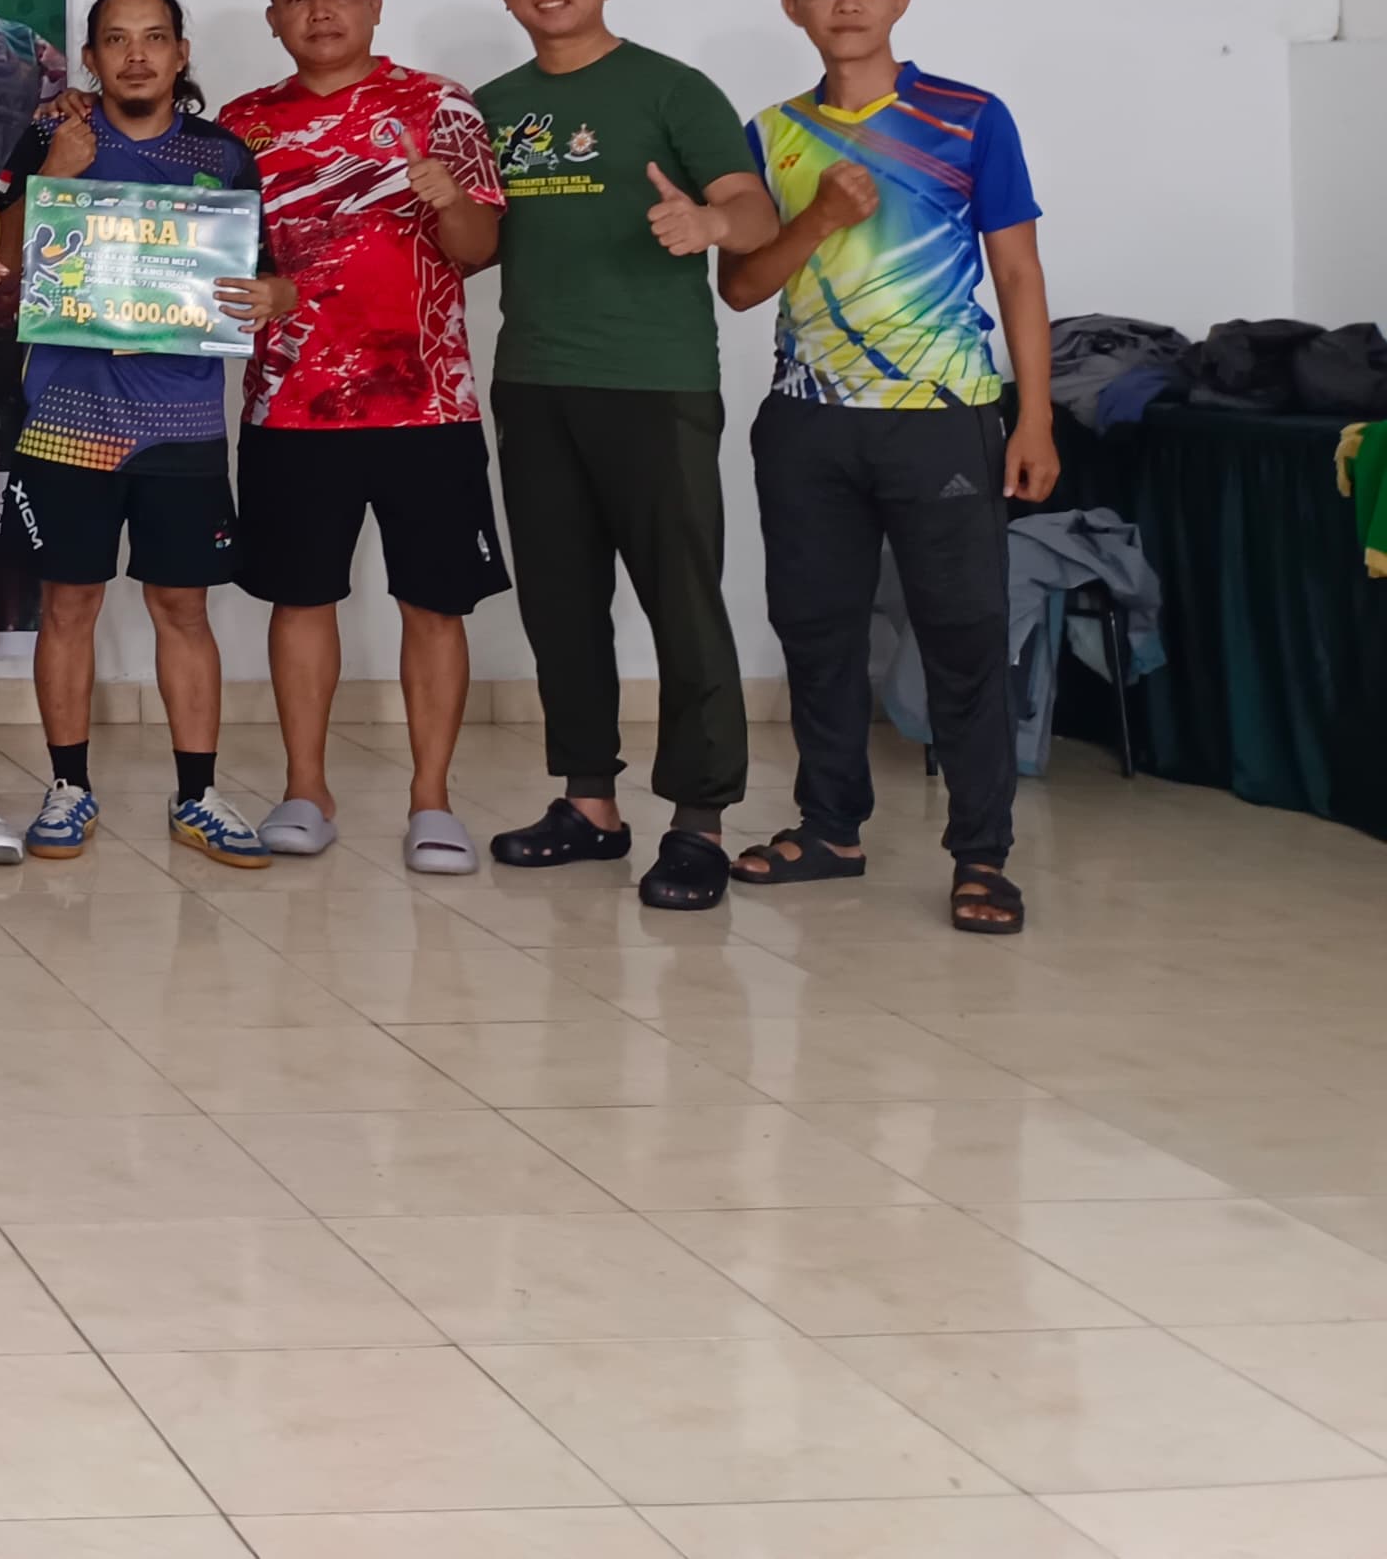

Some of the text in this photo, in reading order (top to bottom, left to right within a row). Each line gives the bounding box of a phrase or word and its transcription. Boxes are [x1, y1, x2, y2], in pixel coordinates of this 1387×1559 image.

[83, 214, 200, 248] JUARA I
[60, 296, 221, 333] Rp. 3.000.000,-
[10, 480, 44, 551] XIOM
